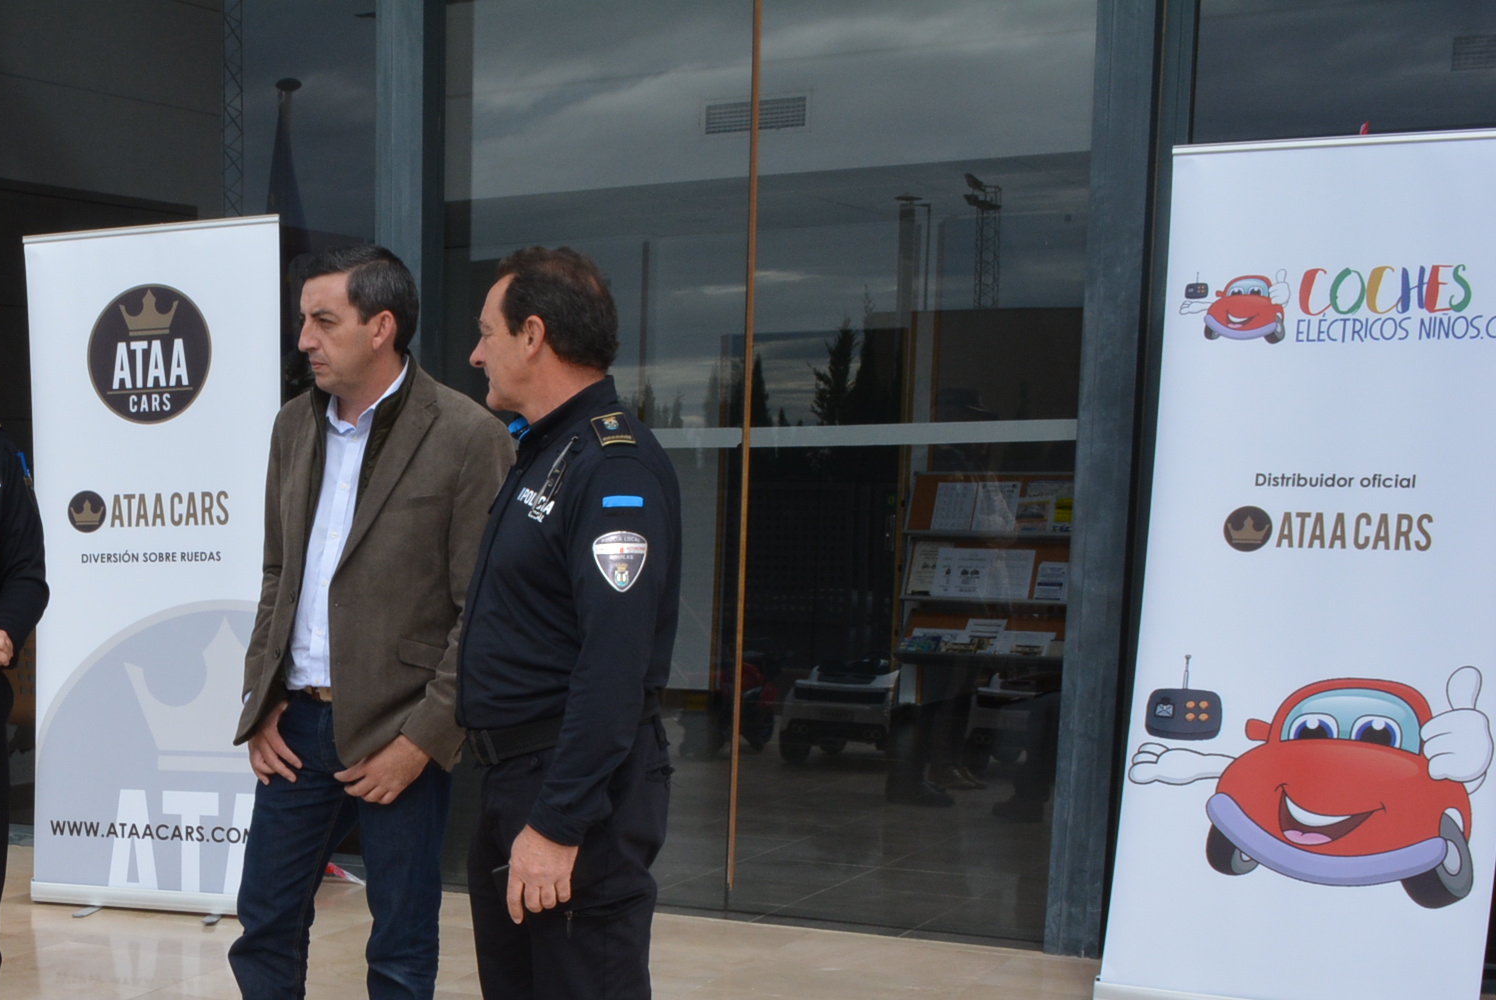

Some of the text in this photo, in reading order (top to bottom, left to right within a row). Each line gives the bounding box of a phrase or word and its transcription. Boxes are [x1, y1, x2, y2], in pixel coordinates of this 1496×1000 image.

[1299, 264, 1472, 317] COCHES
[1295, 313, 1412, 343] ELÉCTRICOS
[112, 338, 189, 390] ATAA
[129, 393, 171, 413] CARS
[1254, 472, 1417, 489] Distribuidor oficial
[81, 550, 222, 564] DIVERSIÓN SOBRE RUEDAS
